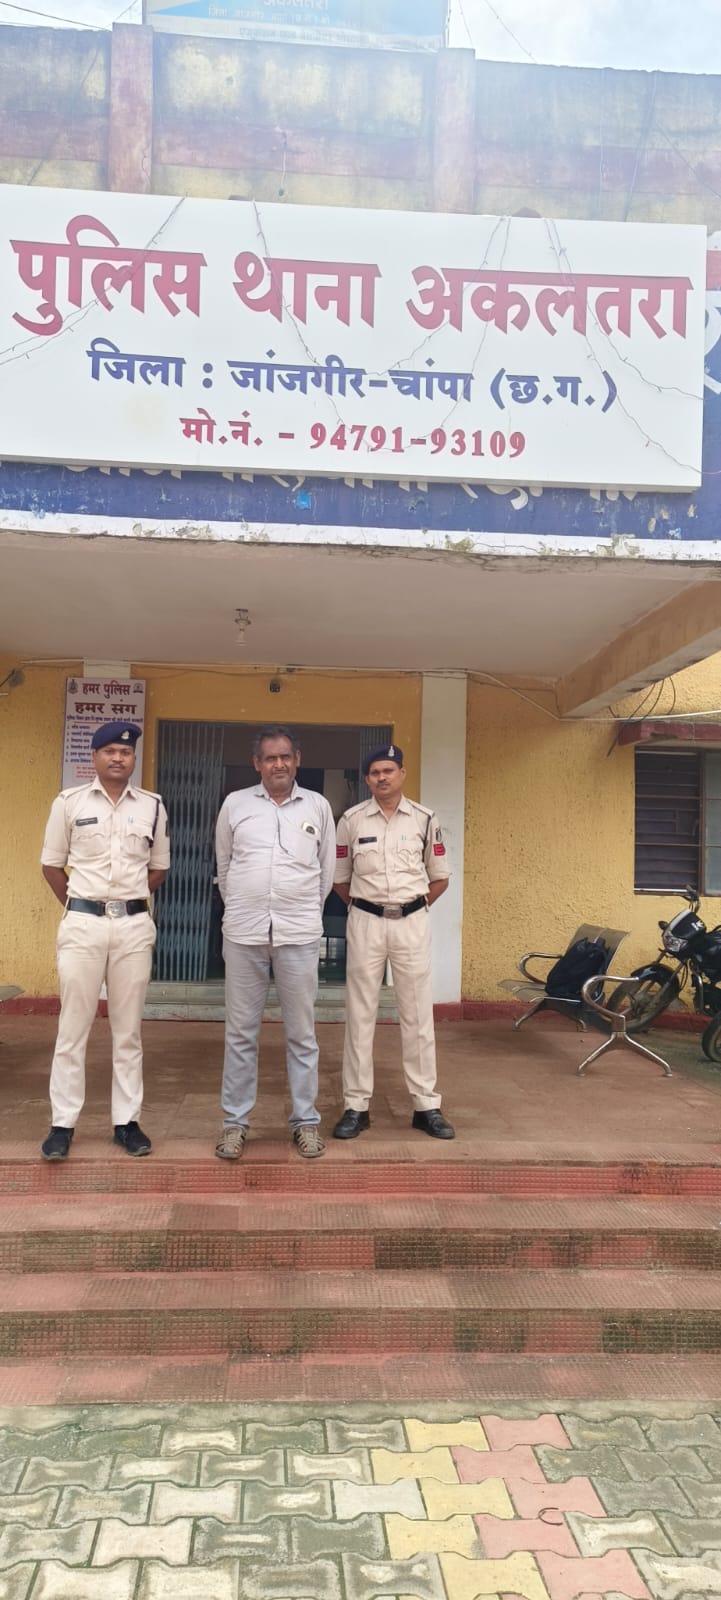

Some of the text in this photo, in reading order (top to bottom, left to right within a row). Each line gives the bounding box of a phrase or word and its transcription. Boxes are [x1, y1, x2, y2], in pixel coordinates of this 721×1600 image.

[11, 215, 693, 340] पुलिस थाना अकलतरा
[86, 337, 186, 387] जिला
[227, 349, 475, 402] जांजगीर-चांपा
[490, 368, 618, 413] (छ.ग.)
[180, 408, 263, 448] मो.नं.
[310, 423, 527, 459] 94791-93109
[75, 699, 137, 714] हमर संग
[82, 680, 131, 699] हमर पुलिस
